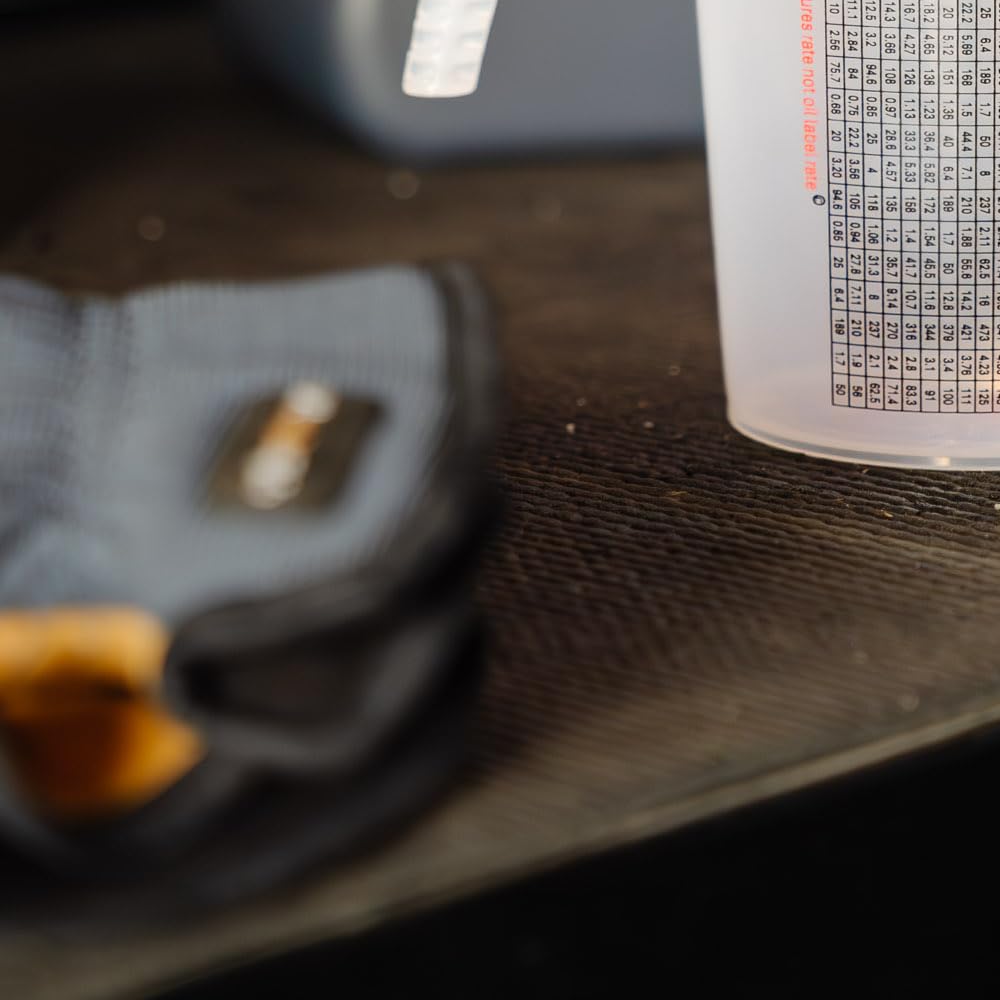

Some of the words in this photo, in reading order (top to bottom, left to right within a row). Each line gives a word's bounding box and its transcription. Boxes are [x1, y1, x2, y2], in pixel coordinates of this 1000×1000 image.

[829, 3, 840, 14] 10
[884, 2, 896, 22] 14.3
[865, 32, 877, 47] 3.2
[904, 34, 916, 55] 4.27
[802, 36, 814, 64] rate
[803, 69, 816, 93] not
[803, 98, 817, 115] oil
[904, 99, 916, 119] 1.13
[980, 102, 991, 117] 1.7
[804, 120, 817, 156] label
[831, 130, 842, 142] 20
[904, 130, 916, 150] 33.3
[804, 162, 817, 190] rate
[832, 157, 842, 178] 3.20
[961, 166, 973, 180] 7.1
[924, 197, 936, 214] 172
[961, 197, 973, 214] 210
[886, 228, 898, 242] 1.2
[943, 232, 954, 246] 1.7
[868, 255, 880, 276] 31.3
[906, 257, 917, 278] 41.7
[851, 286, 862, 305] 7.11
[961, 291, 972, 310] 14.2
[851, 319, 862, 337] 210
[886, 322, 898, 340] 270
[924, 324, 936, 341] 344
[979, 324, 990, 342] 473
[835, 352, 846, 366] 1.7
[887, 356, 898, 370] 2.4
[978, 355, 990, 375] 4.23
[888, 384, 899, 404] 71.4
[961, 389, 972, 404] 111
